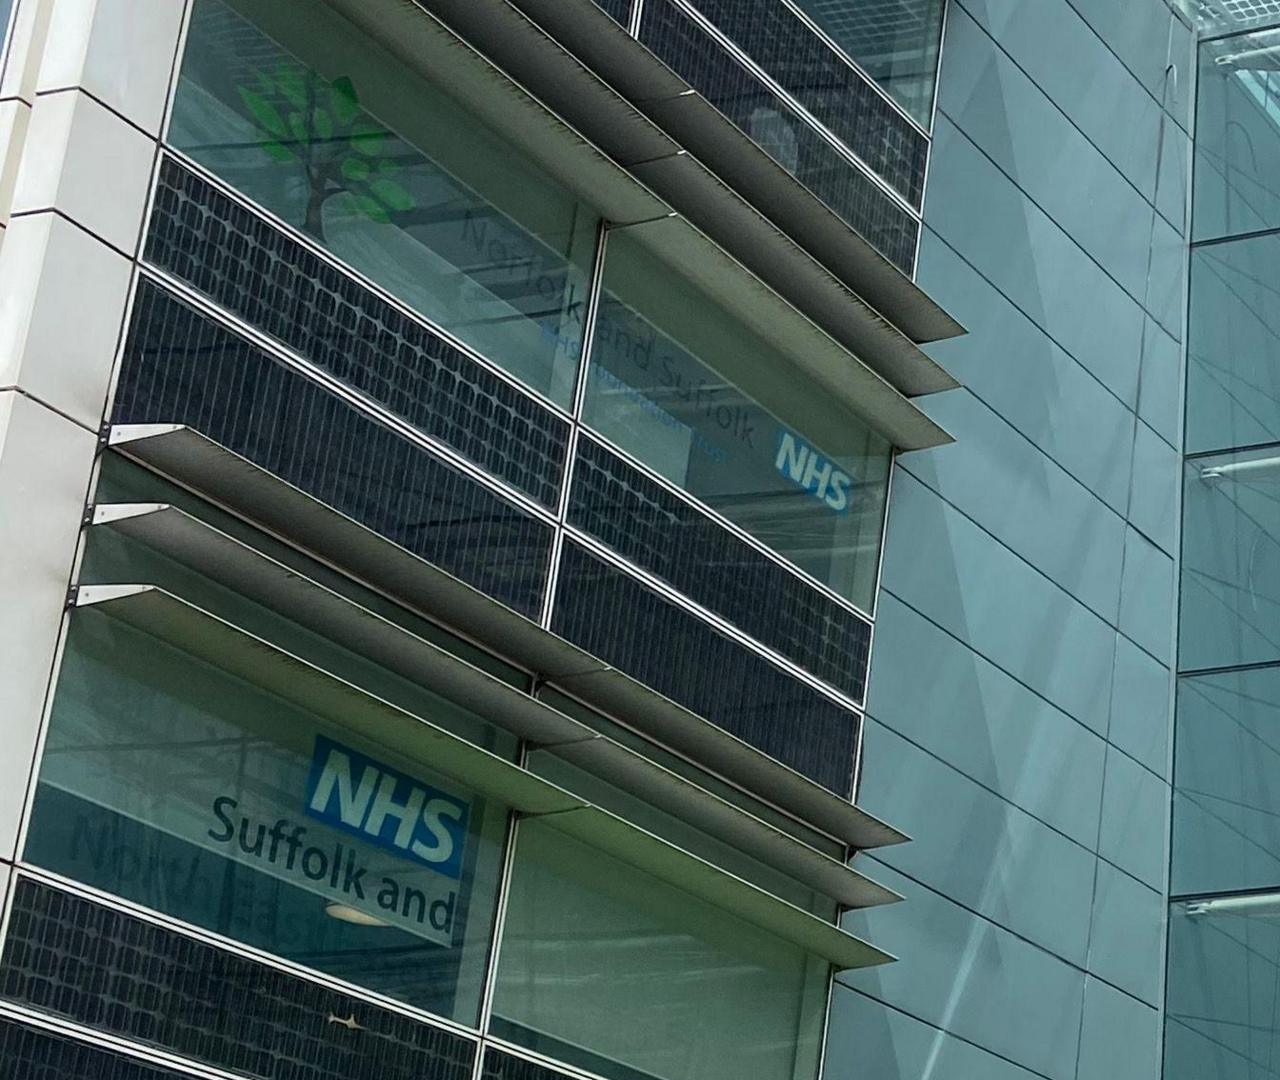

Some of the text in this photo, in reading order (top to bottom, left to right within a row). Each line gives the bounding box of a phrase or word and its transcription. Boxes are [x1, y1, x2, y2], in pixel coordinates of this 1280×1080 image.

[775, 431, 850, 512] NHS
[309, 748, 462, 863] NHS
[207, 796, 456, 934] Suffolk and
